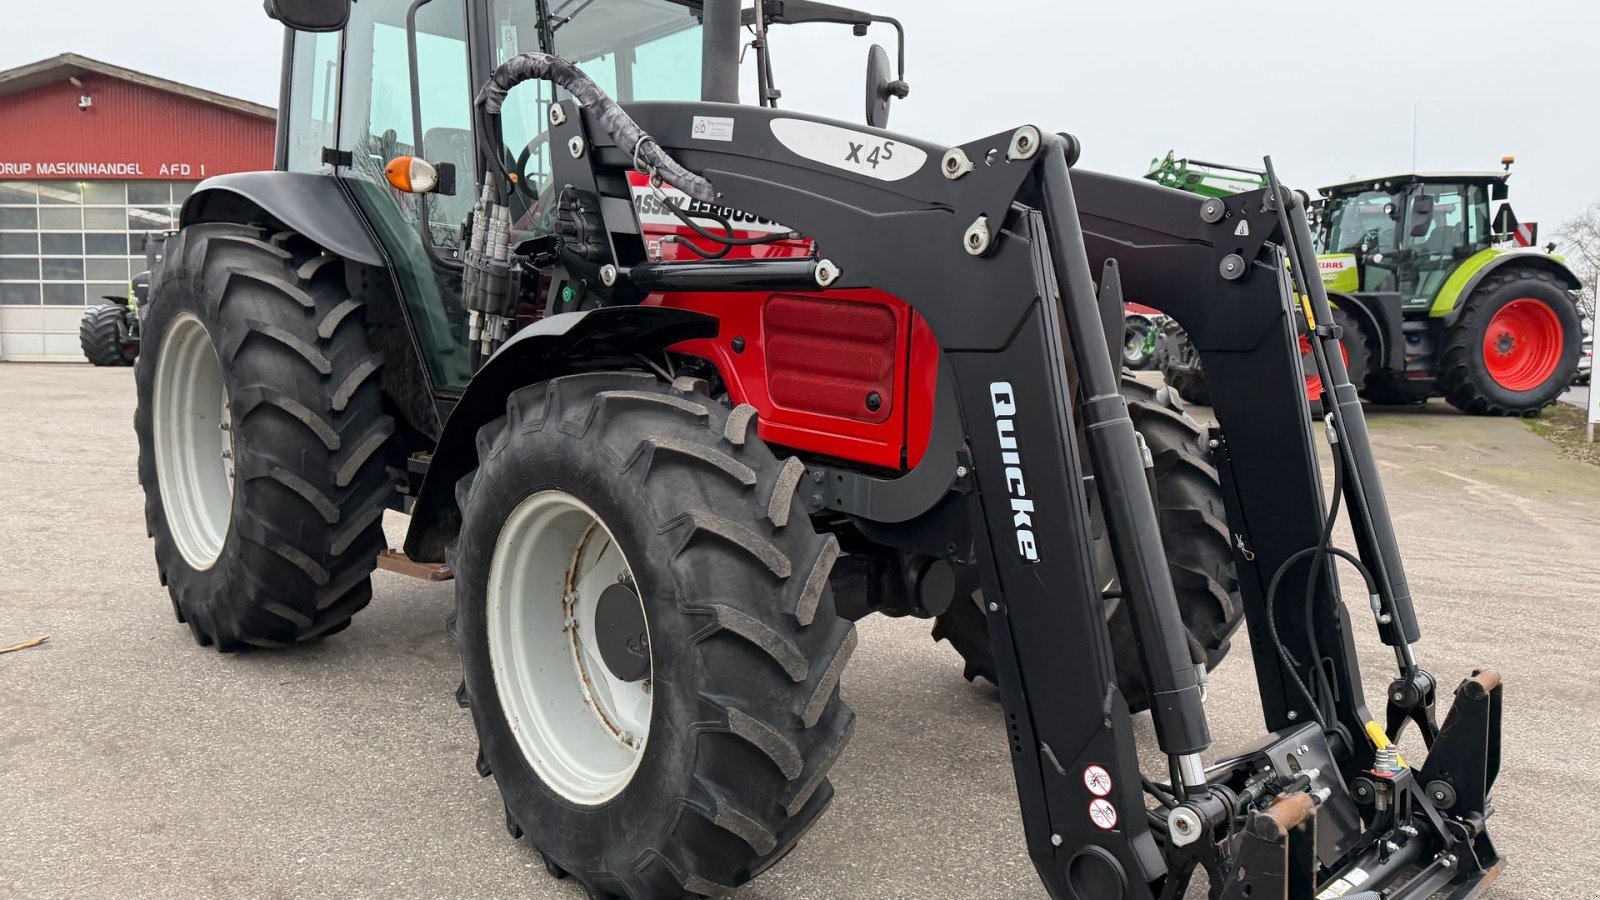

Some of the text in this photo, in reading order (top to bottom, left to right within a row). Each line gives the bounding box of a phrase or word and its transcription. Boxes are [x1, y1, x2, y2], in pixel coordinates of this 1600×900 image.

[36, 162, 144, 175] MASKINHANDEL
[159, 163, 191, 176] AFD
[200, 164, 205, 176] 1
[990, 381, 1038, 560] Quicke
